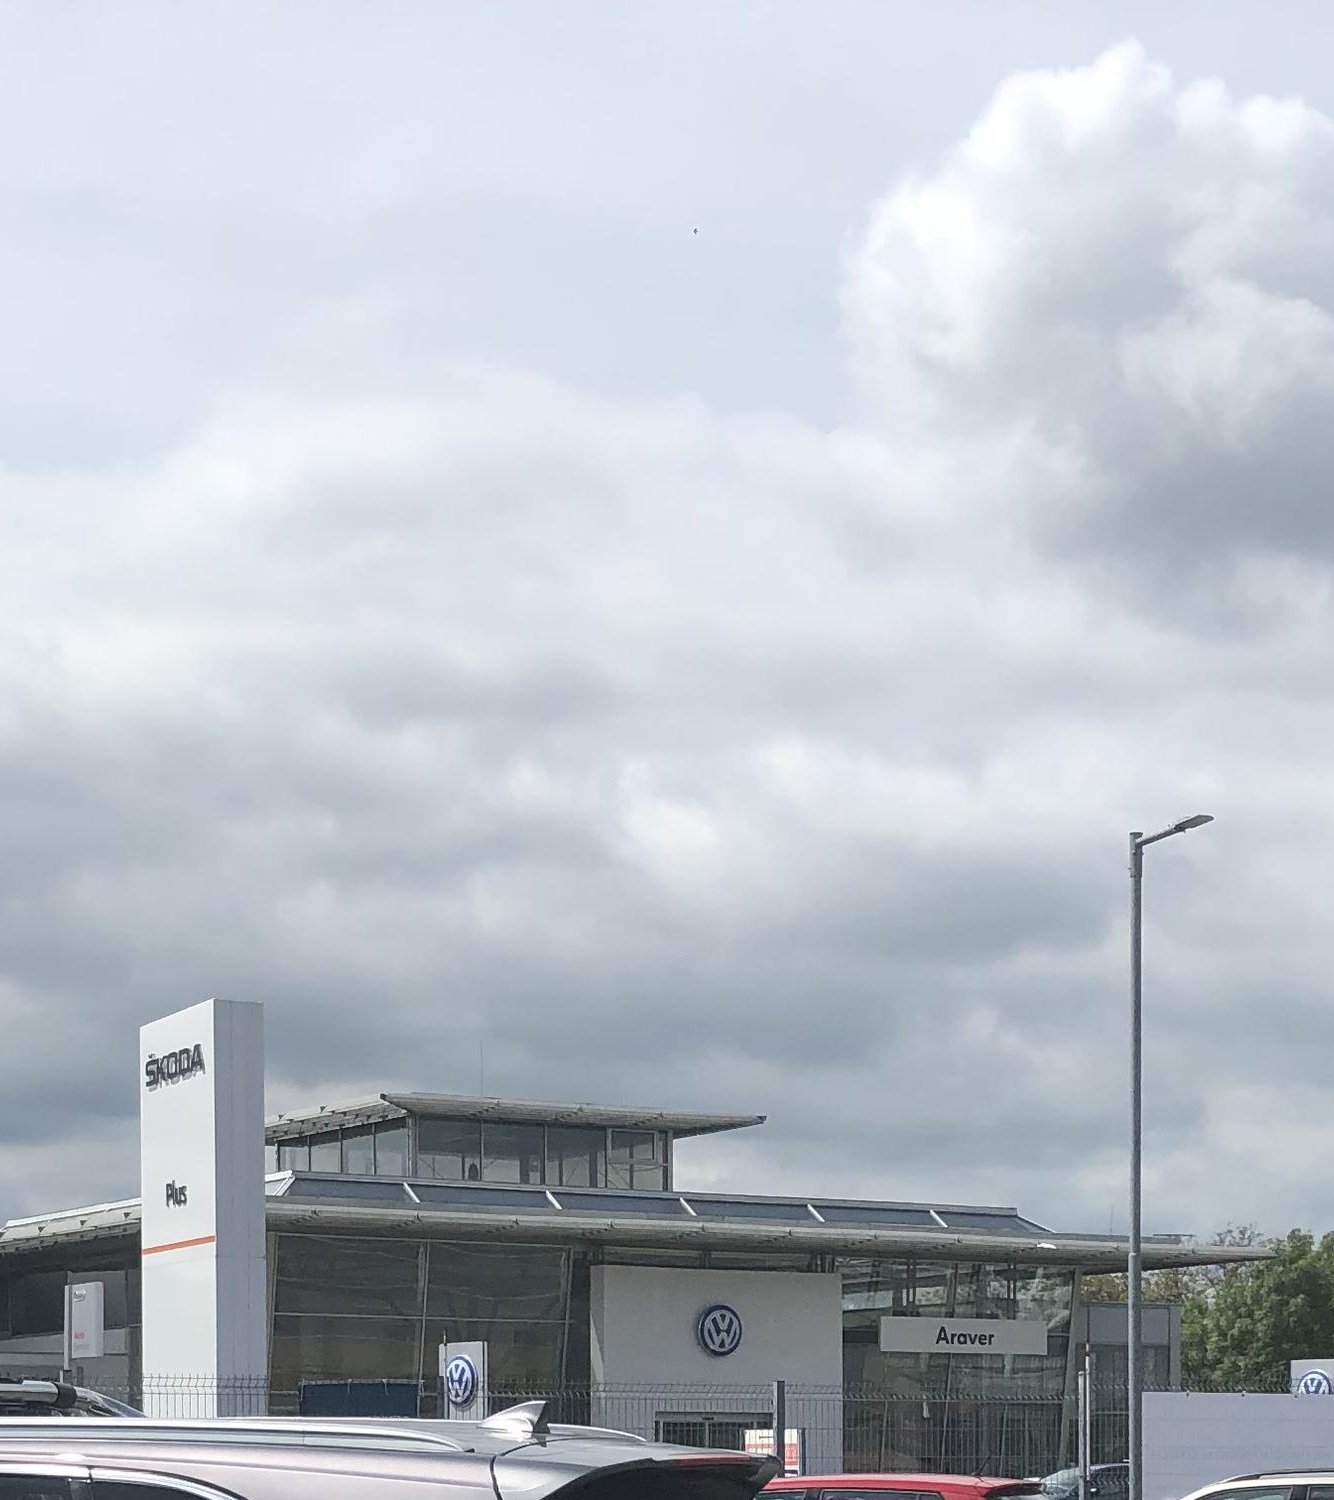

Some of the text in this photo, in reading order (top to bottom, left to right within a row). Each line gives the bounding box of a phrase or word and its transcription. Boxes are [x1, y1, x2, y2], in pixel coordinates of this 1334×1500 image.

[145, 1043, 205, 1089] ŠKODA
[165, 1180, 188, 1208] Plus
[935, 1326, 995, 1345] Araver
